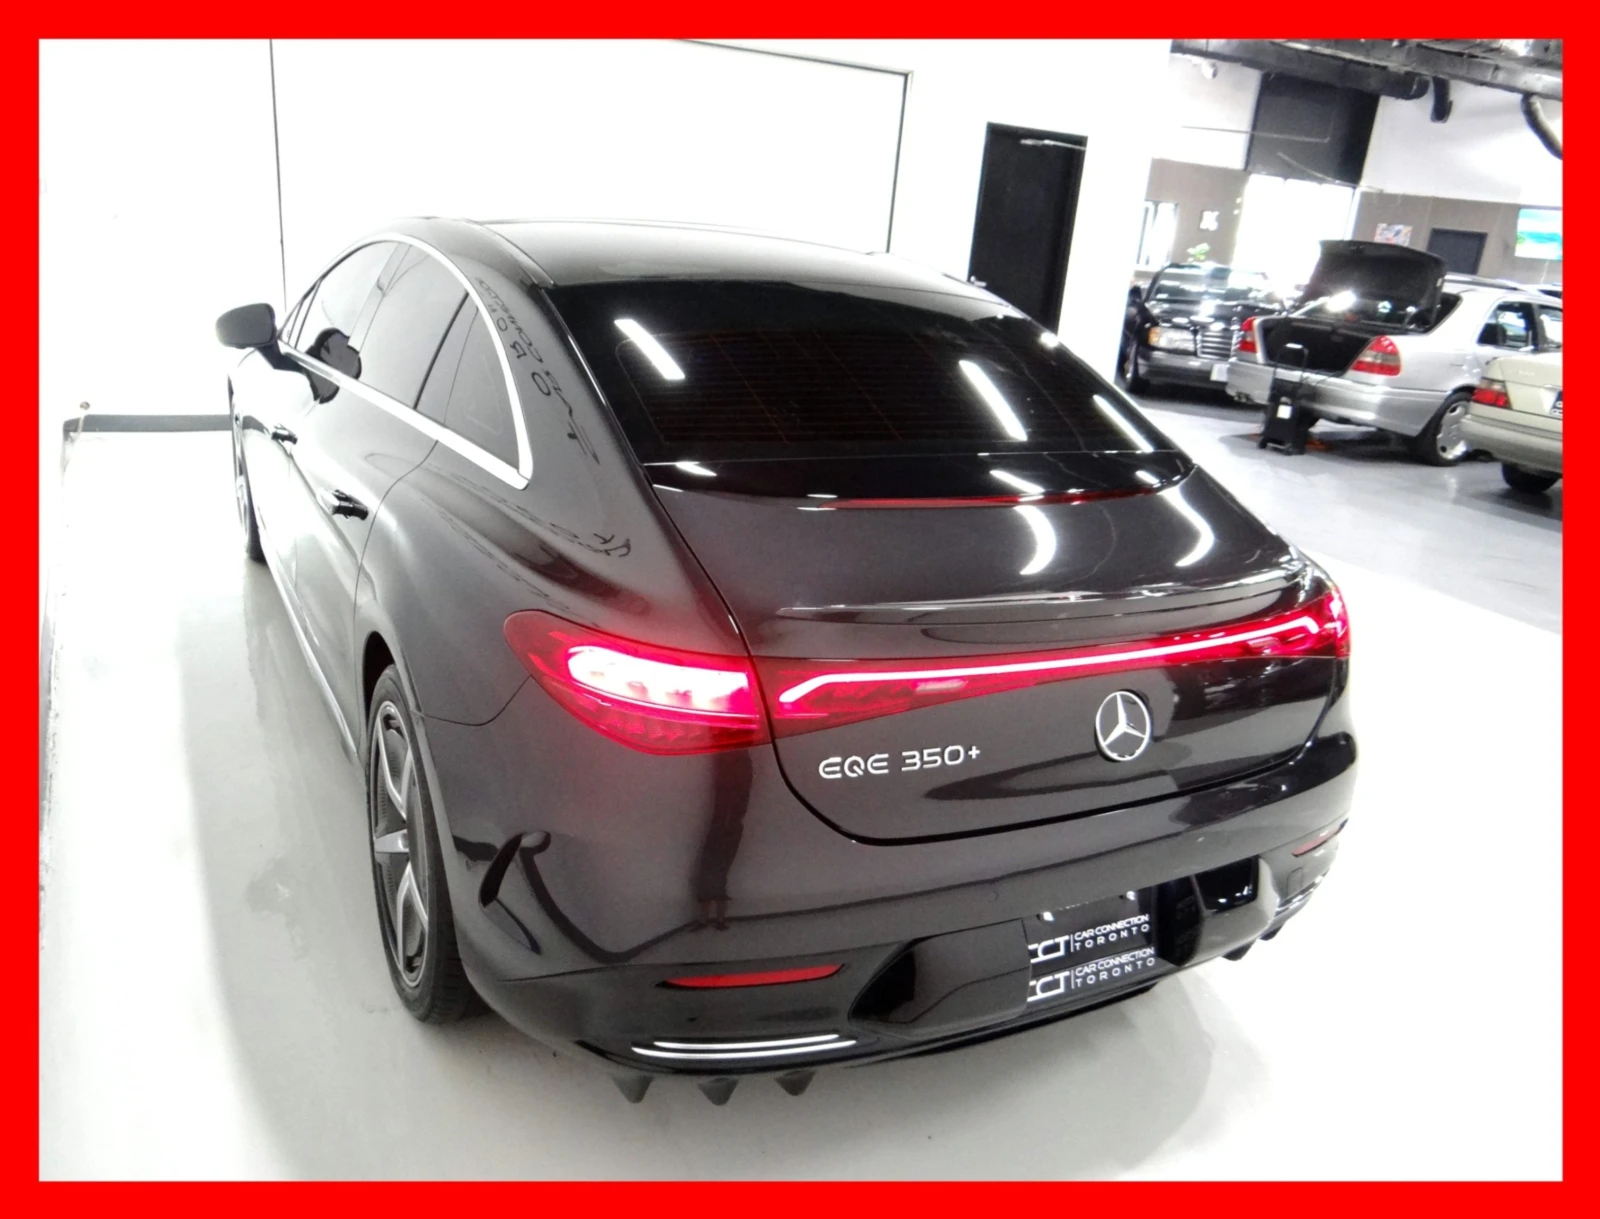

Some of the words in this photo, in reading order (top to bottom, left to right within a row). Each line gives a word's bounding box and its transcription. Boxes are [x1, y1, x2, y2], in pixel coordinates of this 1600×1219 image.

[818, 753, 889, 780] EQE
[901, 745, 981, 772] 350+
[1074, 928, 1095, 941] CAR
[1095, 913, 1149, 936] CONNECTION
[1074, 923, 1150, 951] TORONTO
[1075, 964, 1097, 977] CAR
[1097, 947, 1155, 971] CONNECTION
[1075, 957, 1156, 988] TORONTO
